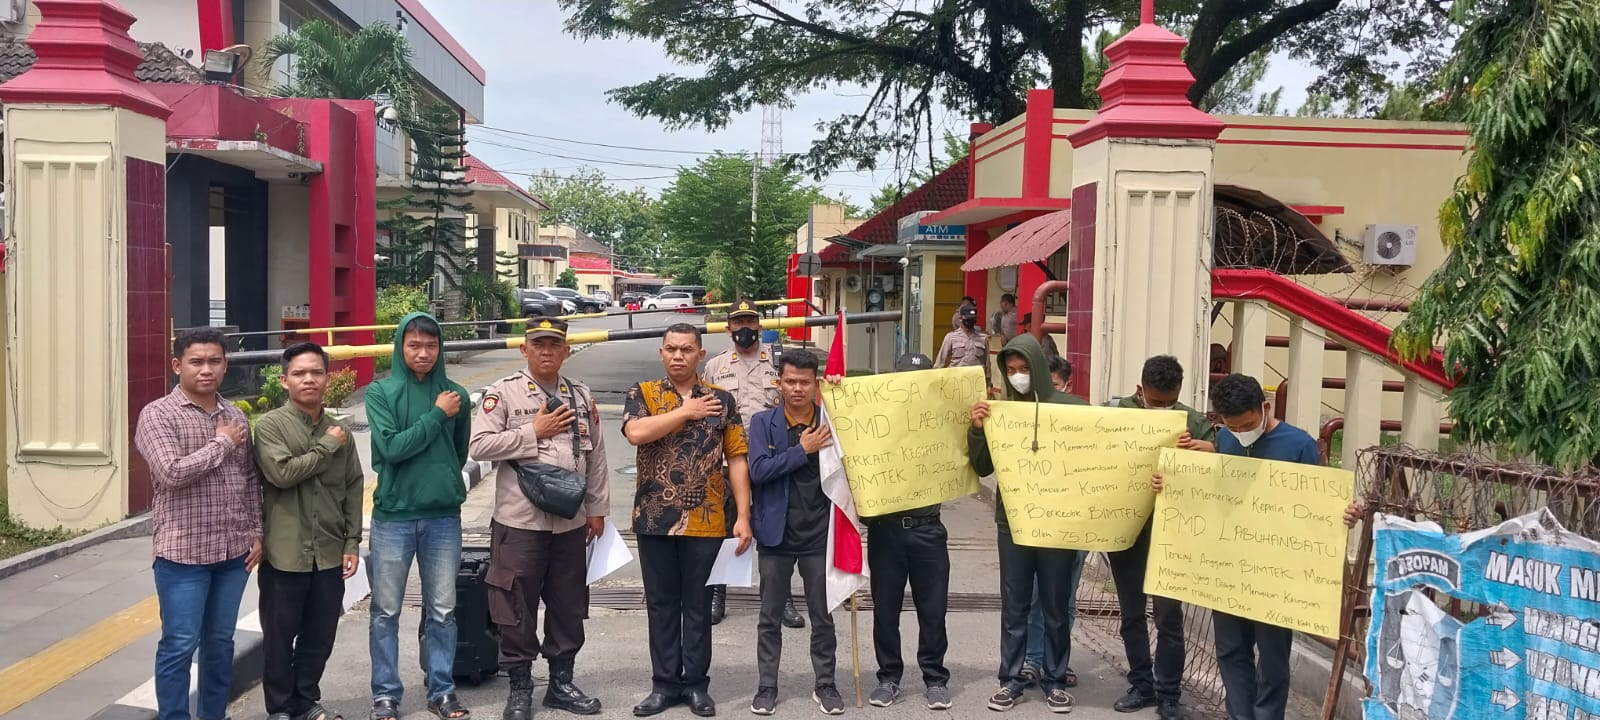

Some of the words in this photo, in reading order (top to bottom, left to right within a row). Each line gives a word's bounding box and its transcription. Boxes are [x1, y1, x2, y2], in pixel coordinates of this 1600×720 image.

[925, 224, 949, 234] ATM
[831, 379, 922, 410] PERIKSA
[831, 414, 891, 441] PMD
[914, 463, 929, 478] TA
[1016, 459, 1052, 477] PMD
[1162, 452, 1212, 479] Meminta
[1269, 463, 1350, 501] KEJATISU
[1087, 505, 1144, 521] BIMTEK
[1059, 531, 1080, 543] 75
[1161, 507, 1207, 537] PMD
[1218, 521, 1337, 558] LABUHANBATU
[1239, 559, 1294, 580] BIMTEK
[1484, 551, 1562, 596] MASUK
